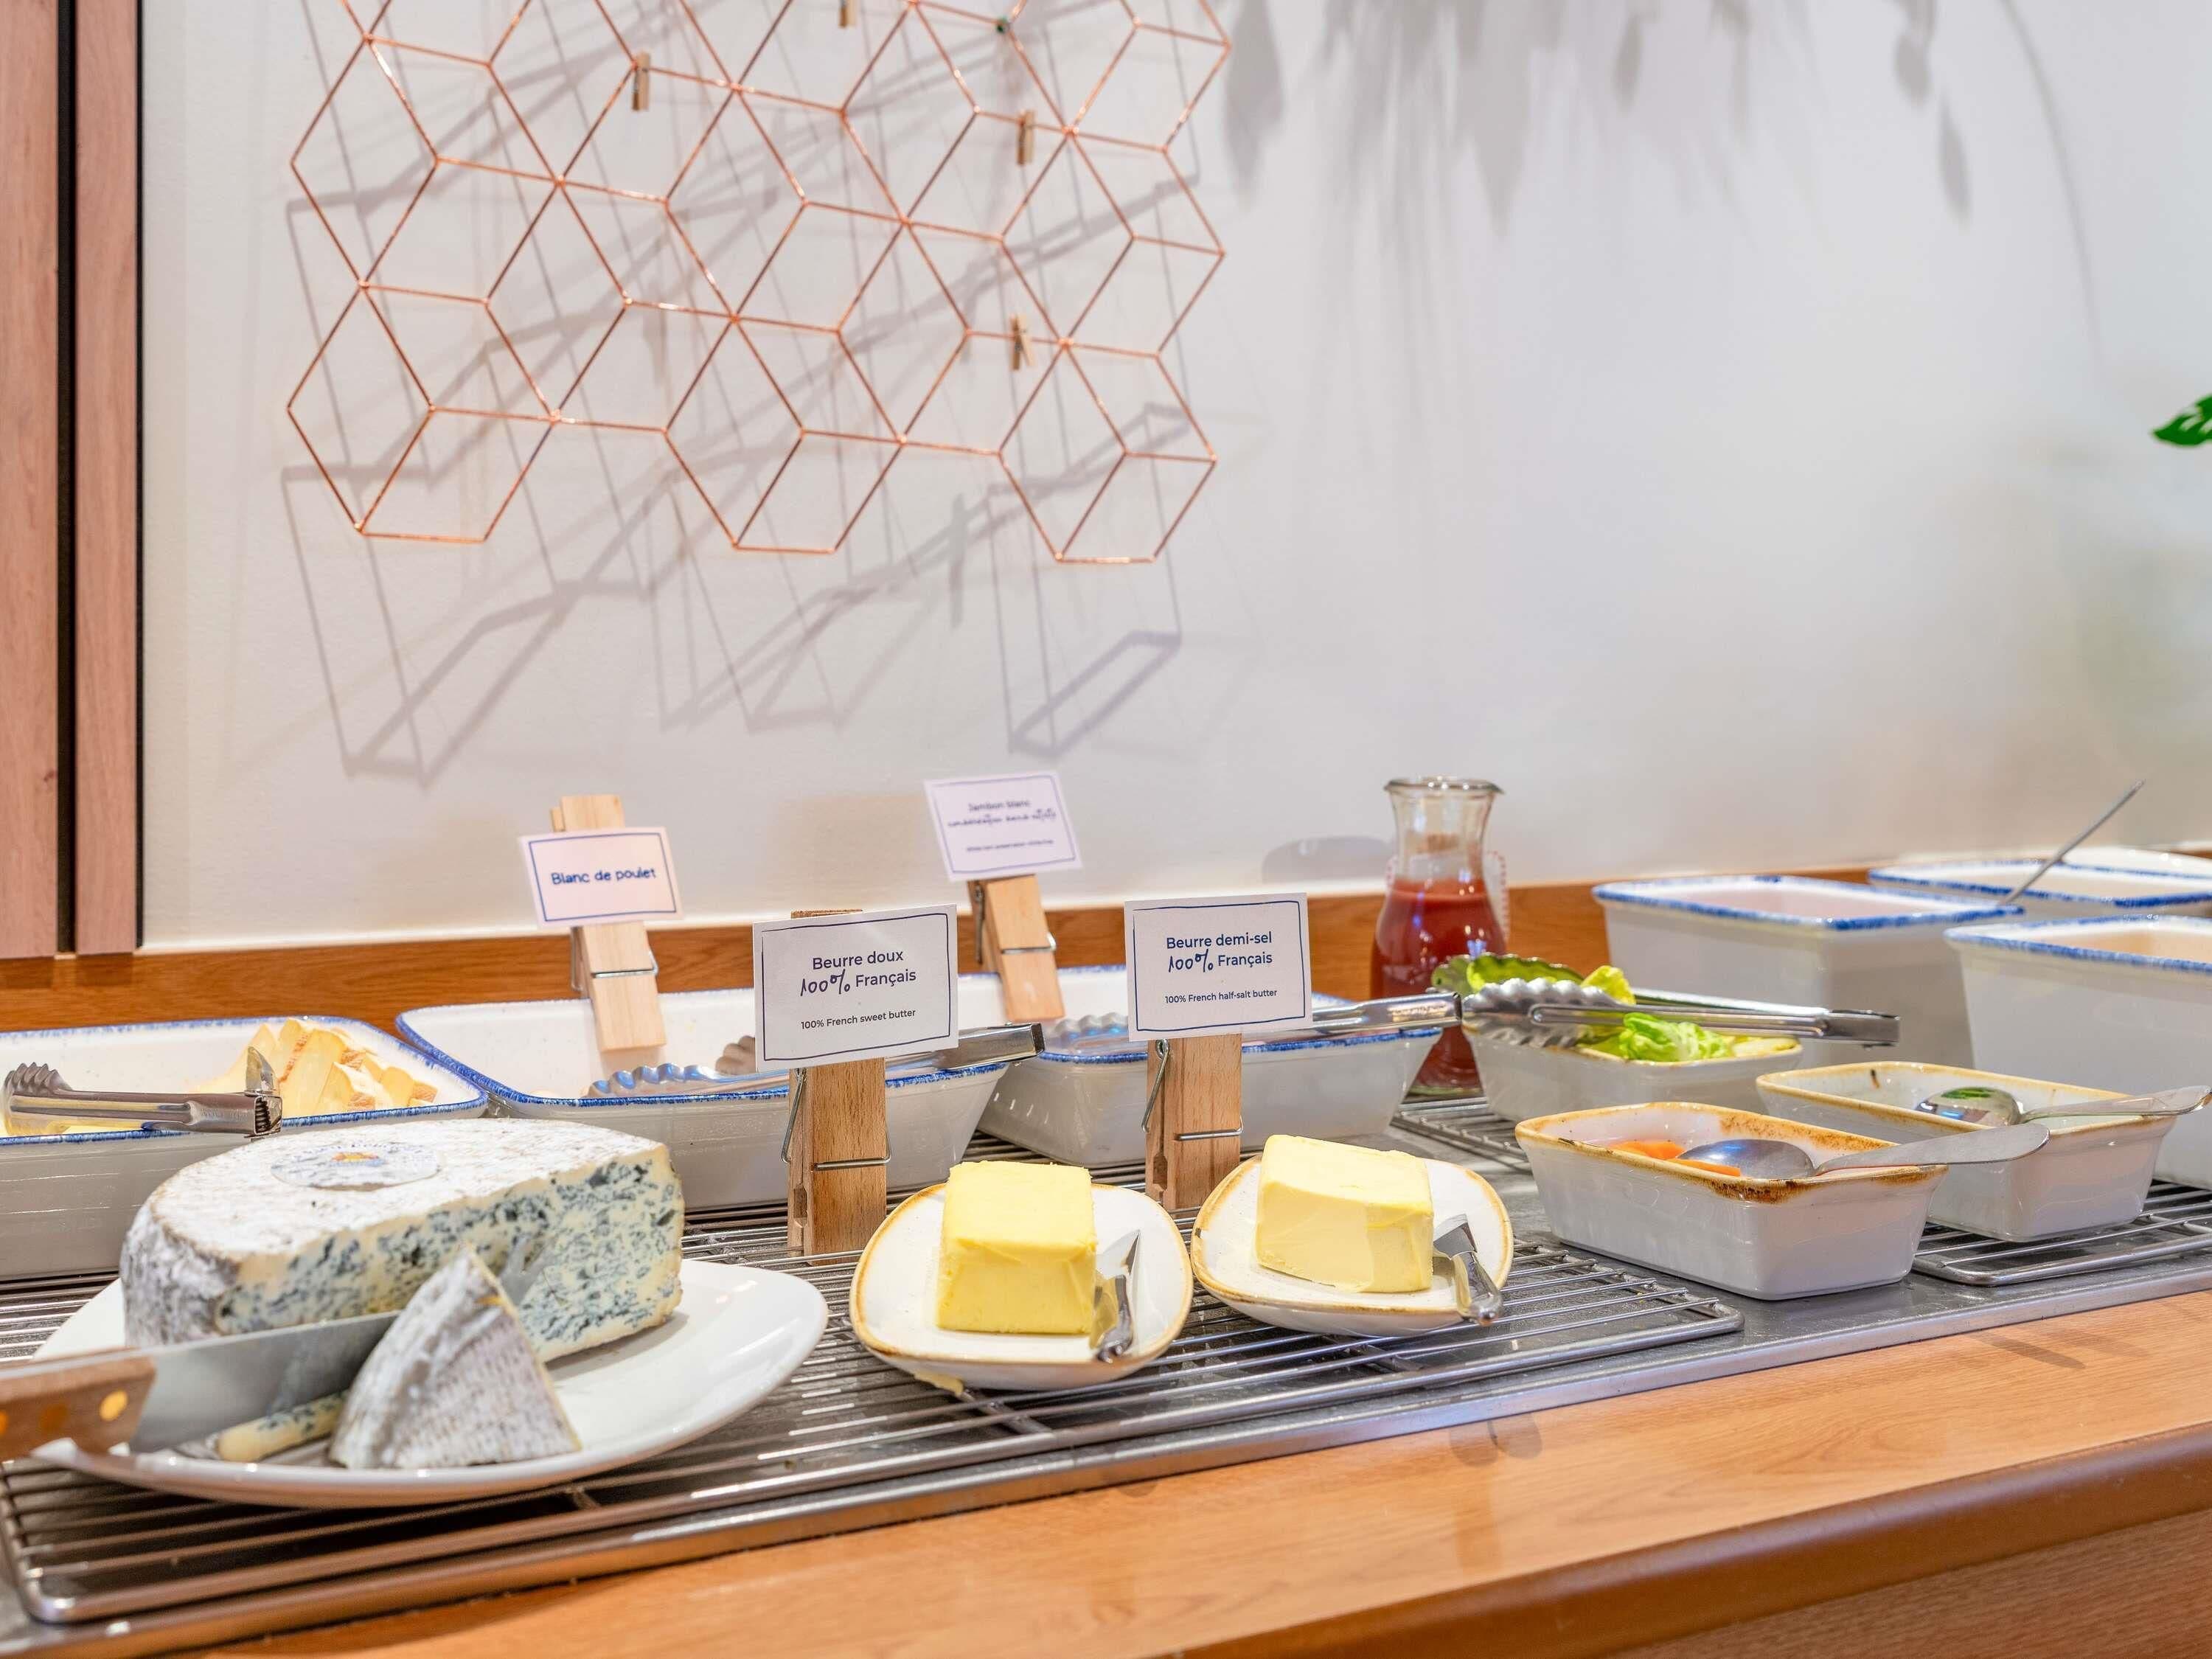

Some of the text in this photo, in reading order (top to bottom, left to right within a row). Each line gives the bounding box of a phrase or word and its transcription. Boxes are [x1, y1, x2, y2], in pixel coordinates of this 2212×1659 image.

[551, 867, 656, 885] Blanc de poulet
[1166, 931, 1273, 949] Beurre demi-sel
[813, 950, 904, 970] Beurre doux
[1168, 948, 1273, 973] 100% Français
[800, 968, 917, 997] 100% Français
[1165, 989, 1278, 1004] 100% French half-salt butter
[801, 1009, 917, 1030] 100% French sweet butter
